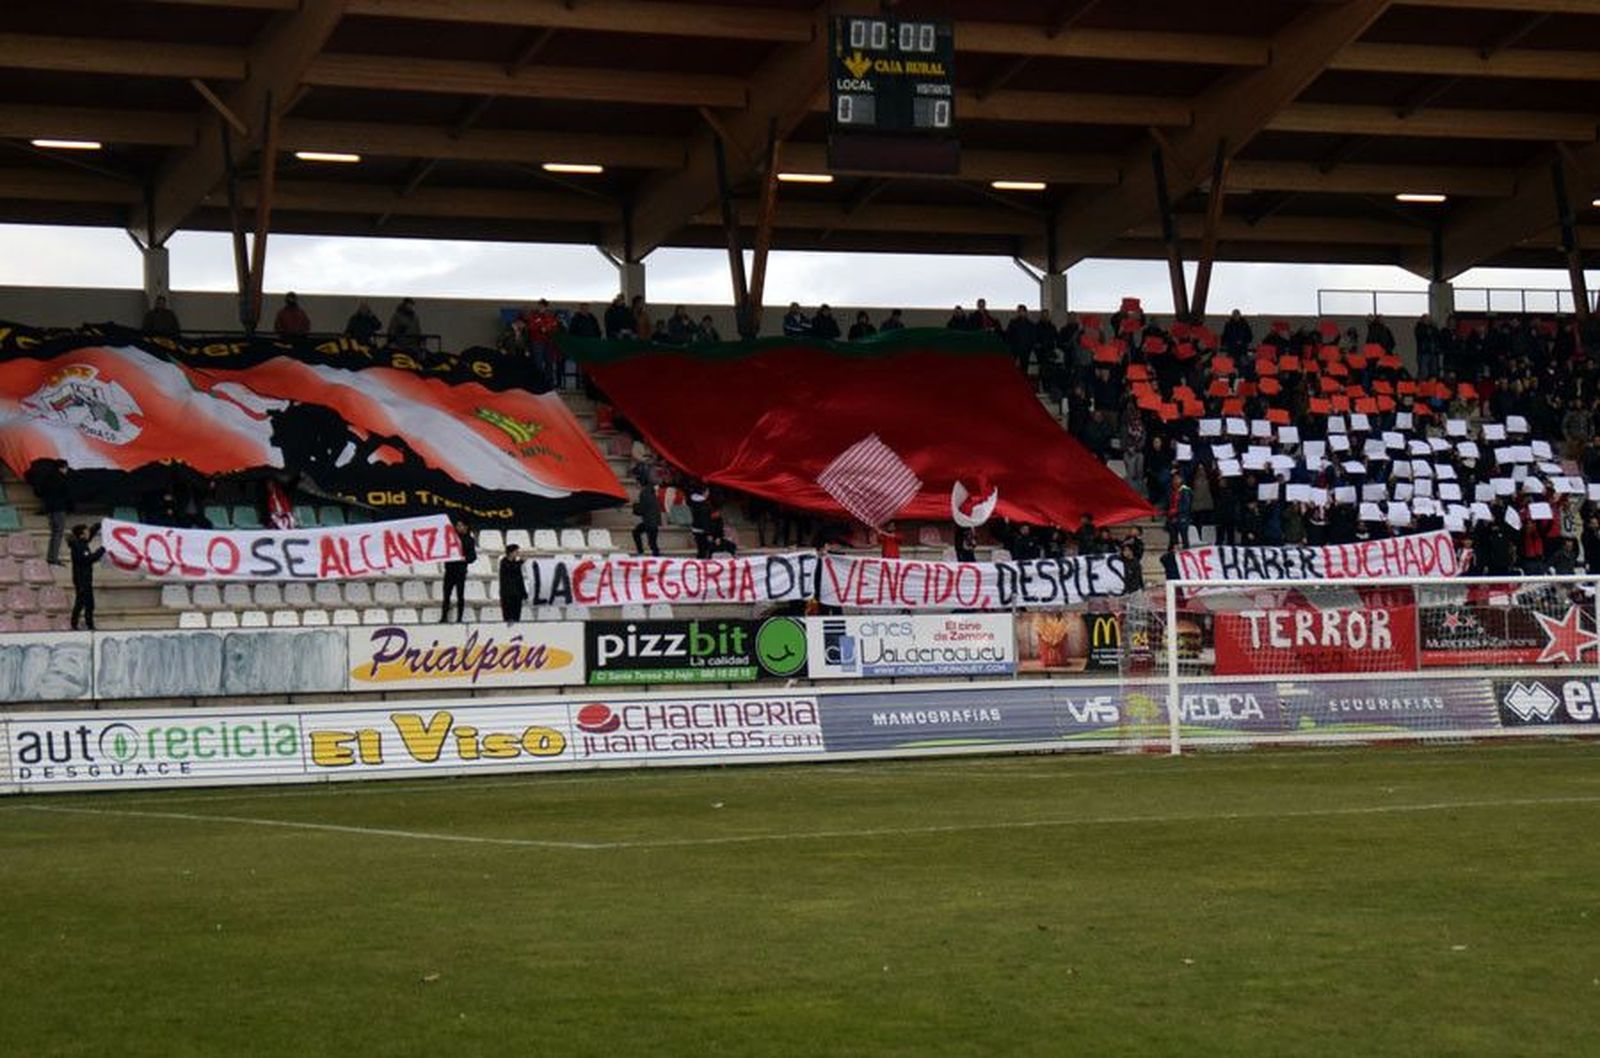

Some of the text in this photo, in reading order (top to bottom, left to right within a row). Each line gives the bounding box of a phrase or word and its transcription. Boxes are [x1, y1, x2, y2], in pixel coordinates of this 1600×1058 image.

[851, 20, 935, 51] 00:00
[837, 79, 873, 91] LOCAL
[837, 96, 852, 122] 0
[935, 101, 949, 127] 0
[367, 491, 406, 505] Old
[251, 537, 317, 577] SE
[317, 524, 463, 577] ALCANZA
[1217, 546, 1323, 580] HABER
[1320, 533, 1456, 578] LUCHADO
[532, 561, 572, 604] LA
[823, 556, 991, 609] VENCIDO,
[945, 621, 956, 630] El
[1240, 609, 1393, 650] TERROR
[597, 622, 748, 667] pizzbit
[690, 655, 750, 667] La calidad
[309, 711, 567, 767] El Viso
[19, 762, 193, 780] DESGUACE
